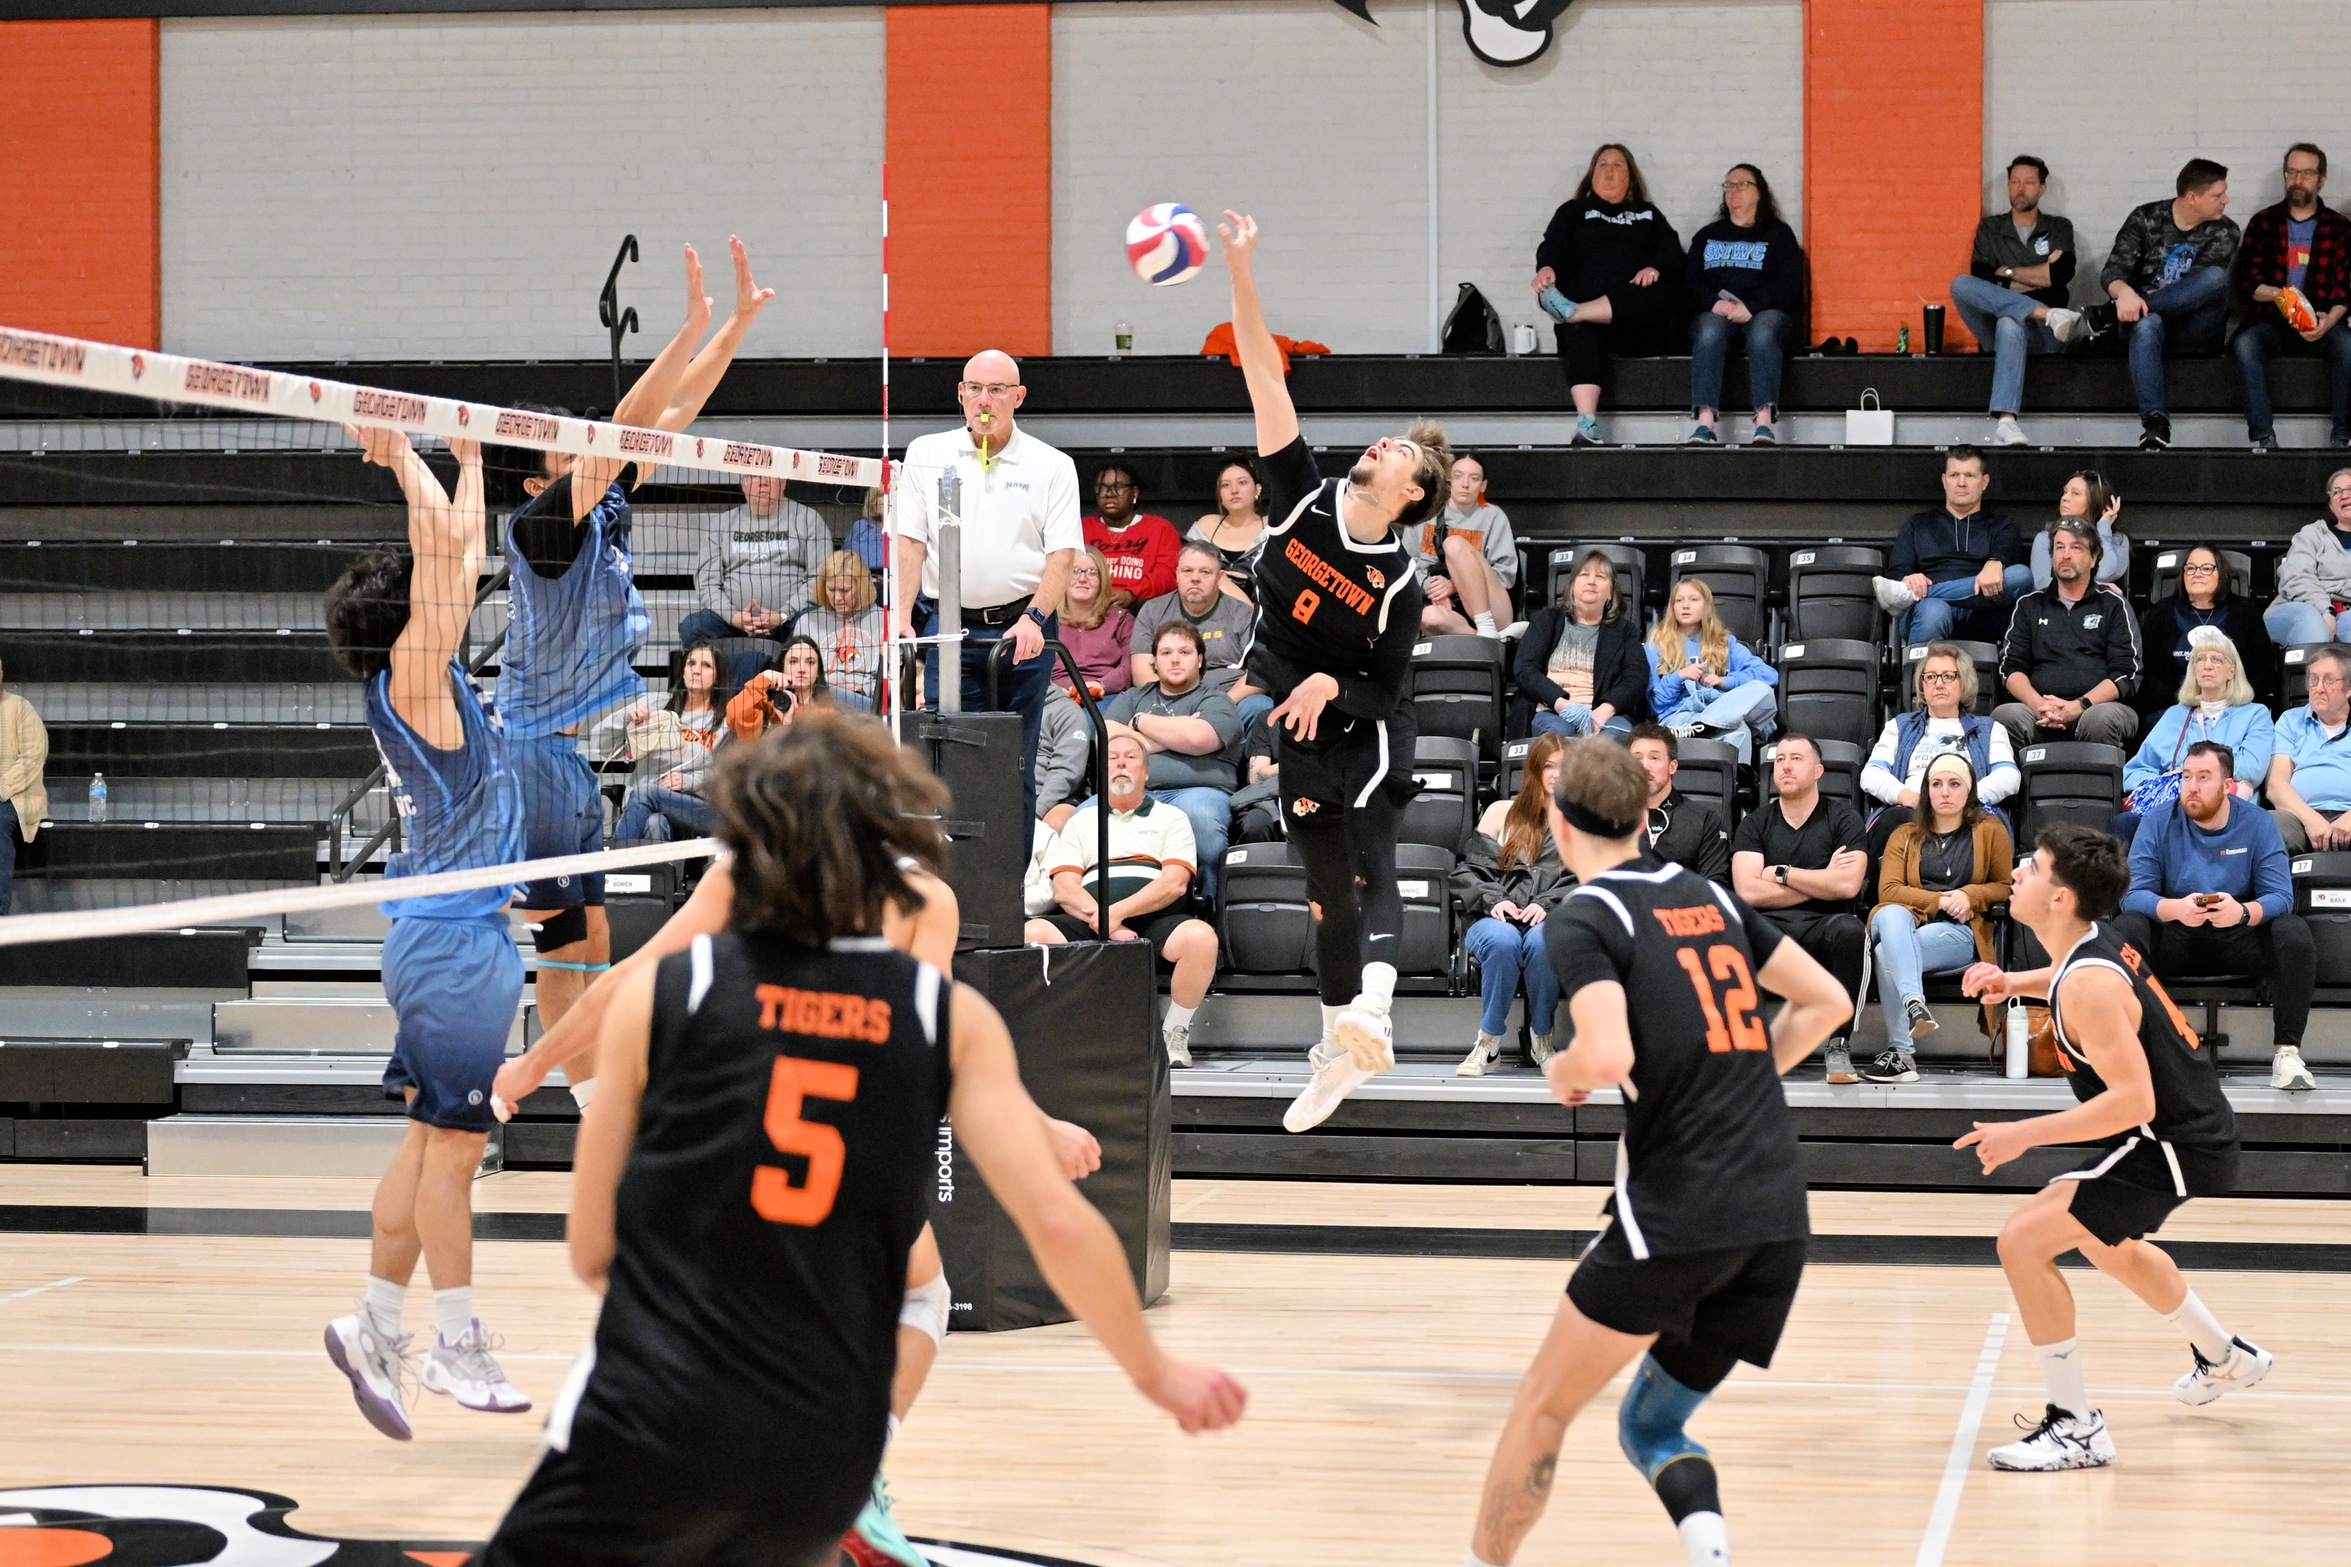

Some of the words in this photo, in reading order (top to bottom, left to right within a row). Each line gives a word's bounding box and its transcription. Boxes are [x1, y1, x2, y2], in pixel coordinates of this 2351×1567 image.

[1704, 241, 1767, 262] SMWC
[0, 333, 86, 373] ORGETOWN
[353, 389, 428, 424] GEORGETOWN
[733, 530, 789, 542] GEORGETOWN
[1089, 537, 1149, 555] Sorry
[1109, 565, 1143, 580] HING
[1120, 556, 1144, 568] DOING
[1285, 537, 1375, 616] GEORGETOWN
[1292, 588, 1320, 625] 9
[2297, 862, 2307, 871] 37
[1653, 903, 1725, 936] TIGERS
[754, 982, 892, 1044] TIGERS
[1676, 944, 1769, 1053] 12
[750, 1055, 859, 1227] 5
[934, 1126, 955, 1202] imports
